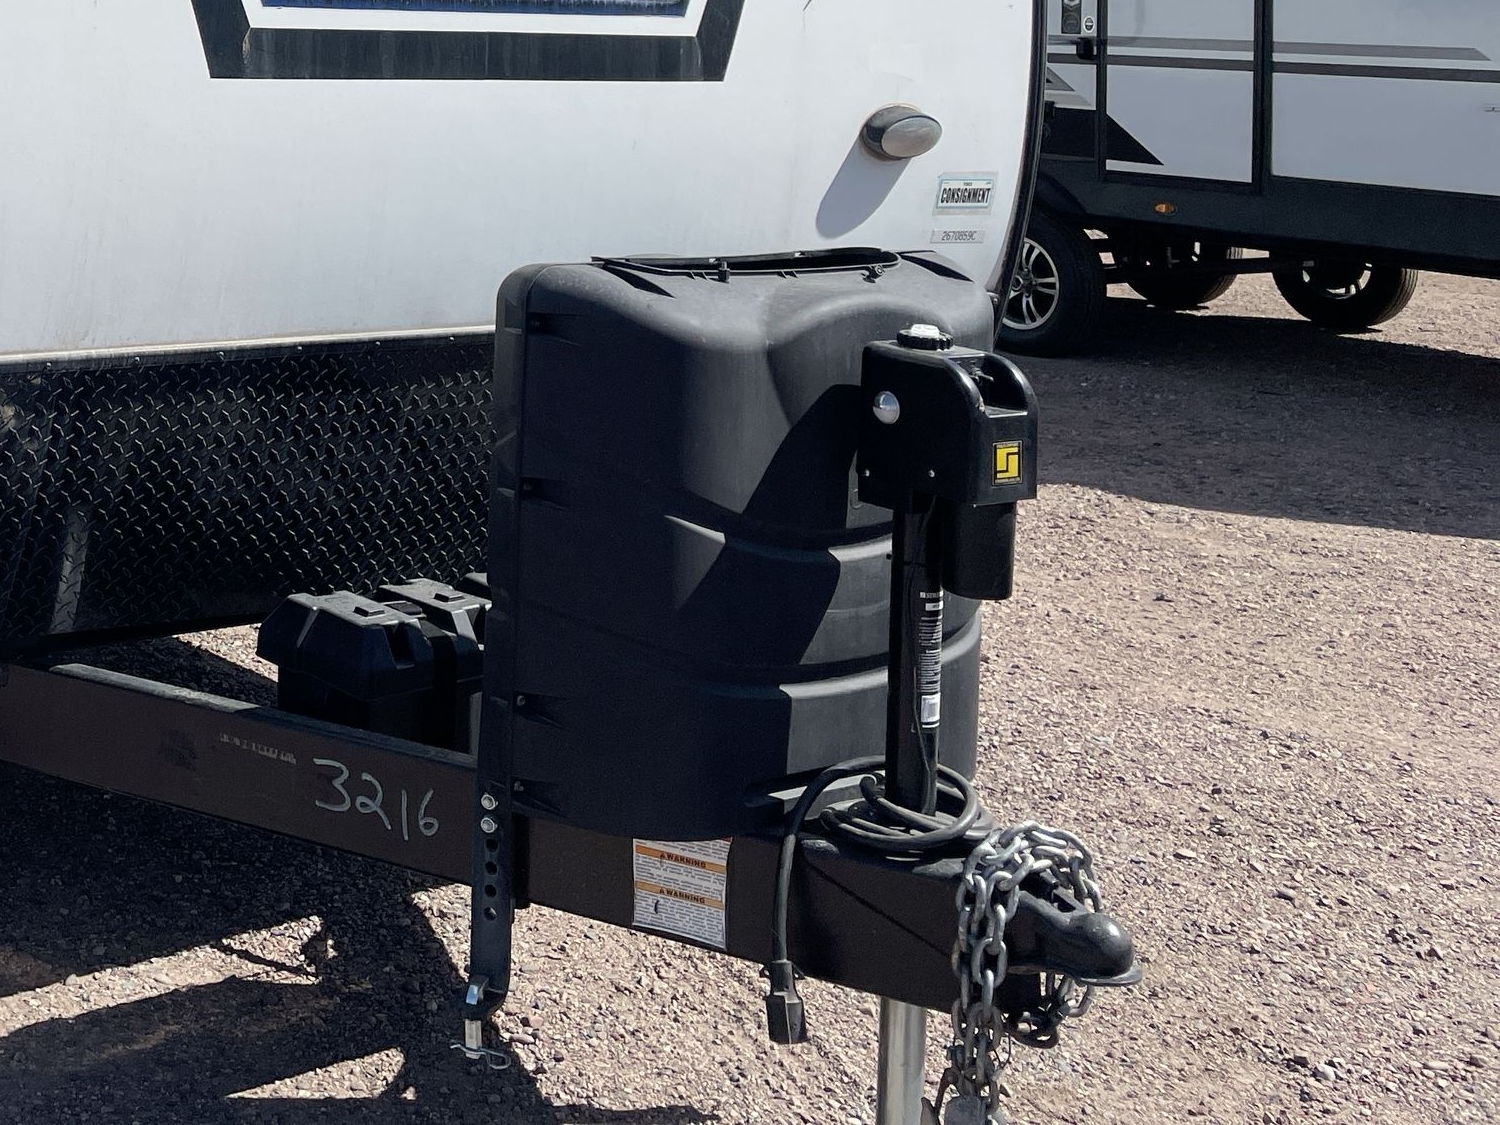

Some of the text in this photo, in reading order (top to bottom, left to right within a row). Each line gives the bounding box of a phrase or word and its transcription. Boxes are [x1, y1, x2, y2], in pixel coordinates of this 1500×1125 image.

[940, 188, 991, 204] CONSIGNMENT
[312, 757, 440, 841] 3216
[667, 853, 707, 868] WARNING
[666, 889, 706, 904] WARNING
